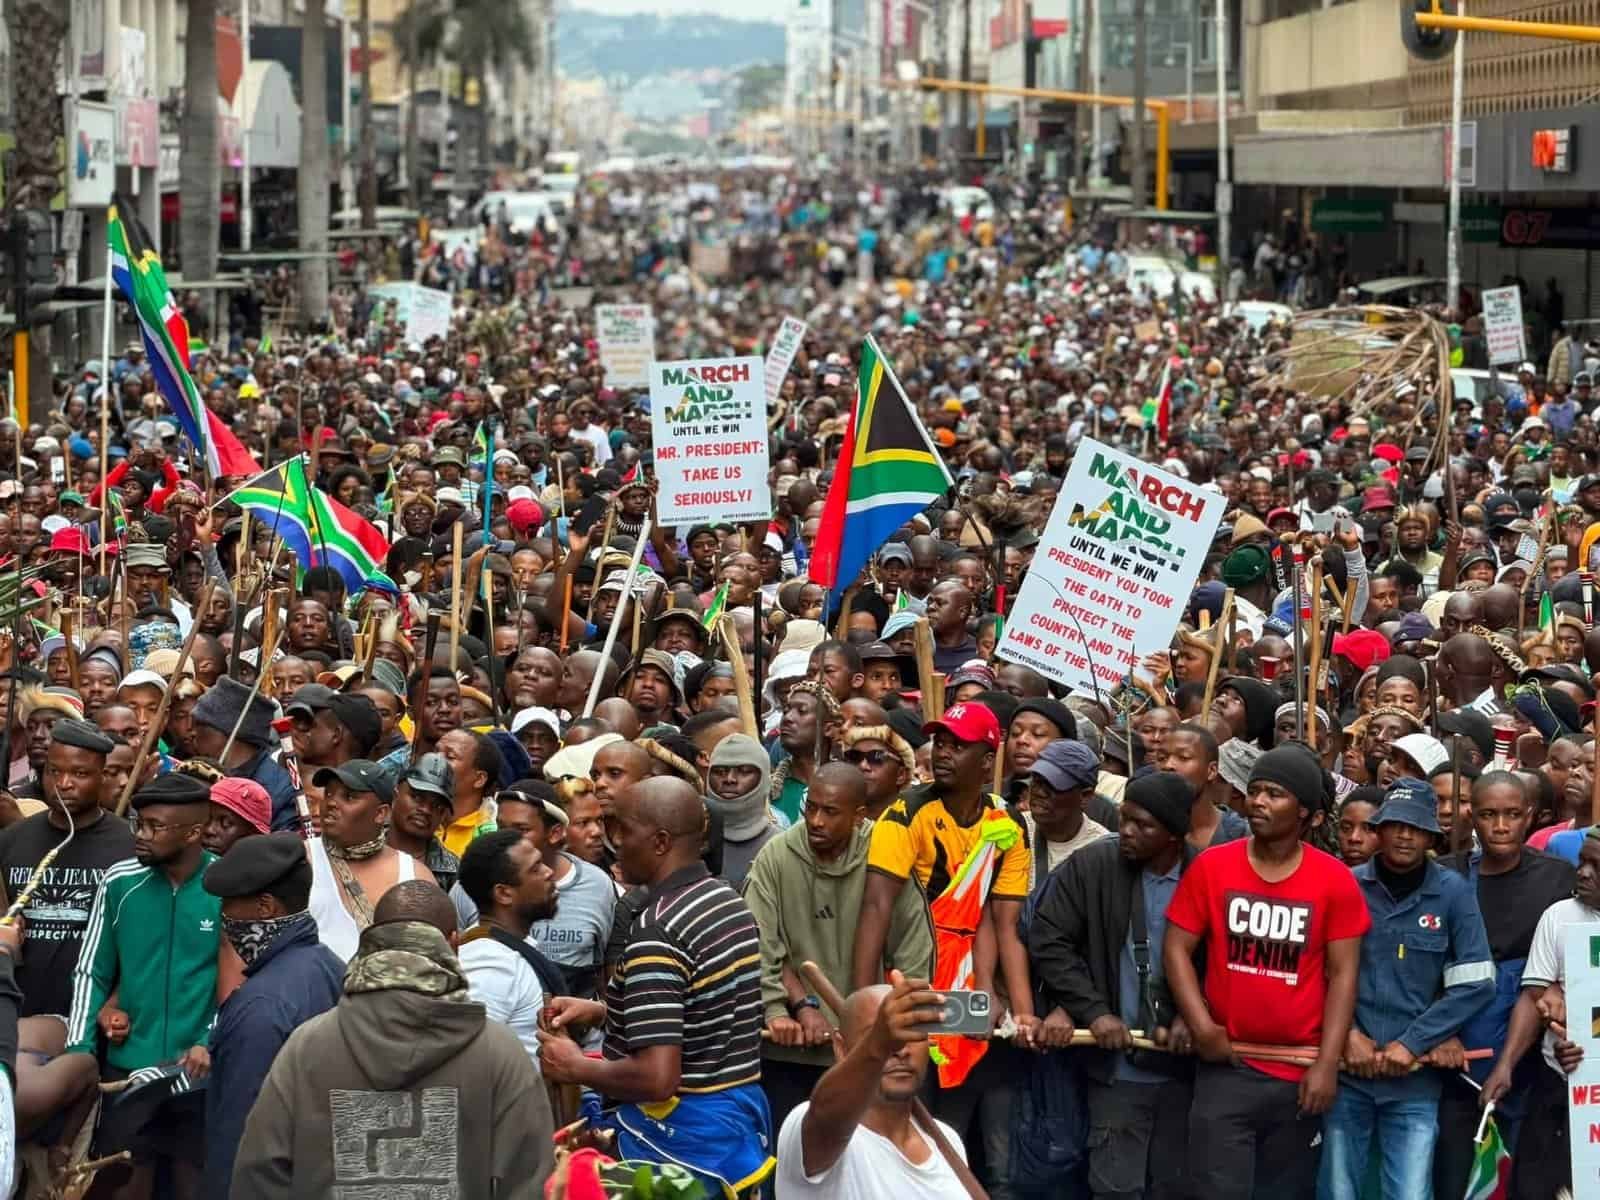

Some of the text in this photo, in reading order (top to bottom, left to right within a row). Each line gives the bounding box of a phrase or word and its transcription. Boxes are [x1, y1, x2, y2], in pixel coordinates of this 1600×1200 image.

[662, 364, 750, 386] MARCH
[681, 385, 734, 403] AND
[664, 401, 752, 423] MARCH
[673, 423, 740, 437] UNTIL WE WIN
[657, 441, 764, 460] MR. PRESIDENT:
[682, 466, 742, 482] TAKE US
[1088, 453, 1206, 522] MARCH
[674, 489, 752, 506] SERIOUSLY!
[1098, 491, 1171, 535] AND
[1068, 502, 1186, 572] MARCH
[1048, 547, 1173, 608] PRESIDENT YOU TOOK
[1070, 535, 1158, 583] UNTIL WE WIN
[1063, 577, 1142, 619] THE OATH TO
[1030, 613, 1141, 668] COUNTRY AND THE
[1052, 598, 1135, 641] PROTECT THE
[1008, 627, 1042, 650] LAWS
[1044, 643, 1061, 656] OF
[1063, 651, 1088, 669] THE
[543, 924, 584, 943] Jeans
[1229, 897, 1308, 943] CODE
[1227, 935, 1301, 973] DENIM
